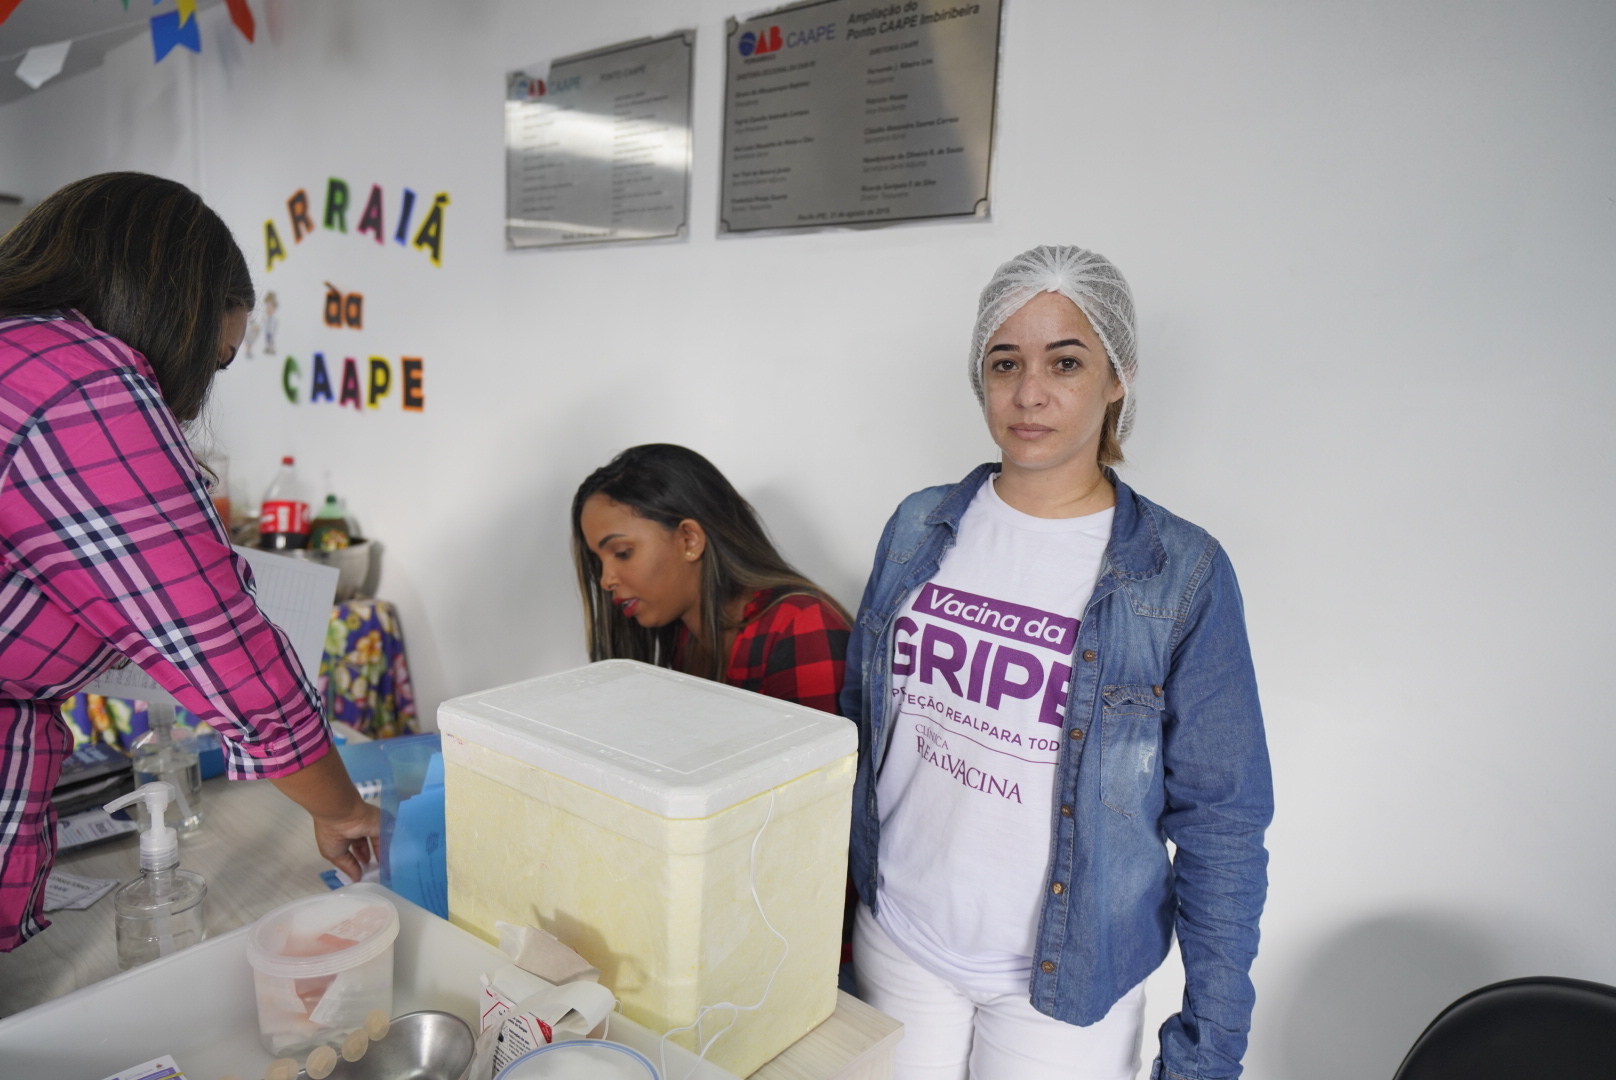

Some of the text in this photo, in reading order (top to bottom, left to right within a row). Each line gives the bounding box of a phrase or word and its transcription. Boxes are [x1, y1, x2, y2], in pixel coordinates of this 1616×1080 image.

[846, 27, 877, 40] Ponto
[879, 15, 919, 34] CAAPE
[903, 1, 918, 13] do
[786, 23, 836, 48] CAAPE
[264, 176, 451, 274] ARRAIÁ
[282, 352, 425, 413] CAAPE
[930, 589, 1067, 644] Vacina da
[892, 616, 1073, 728] GRIPE
[915, 723, 949, 751] CLÍNICA
